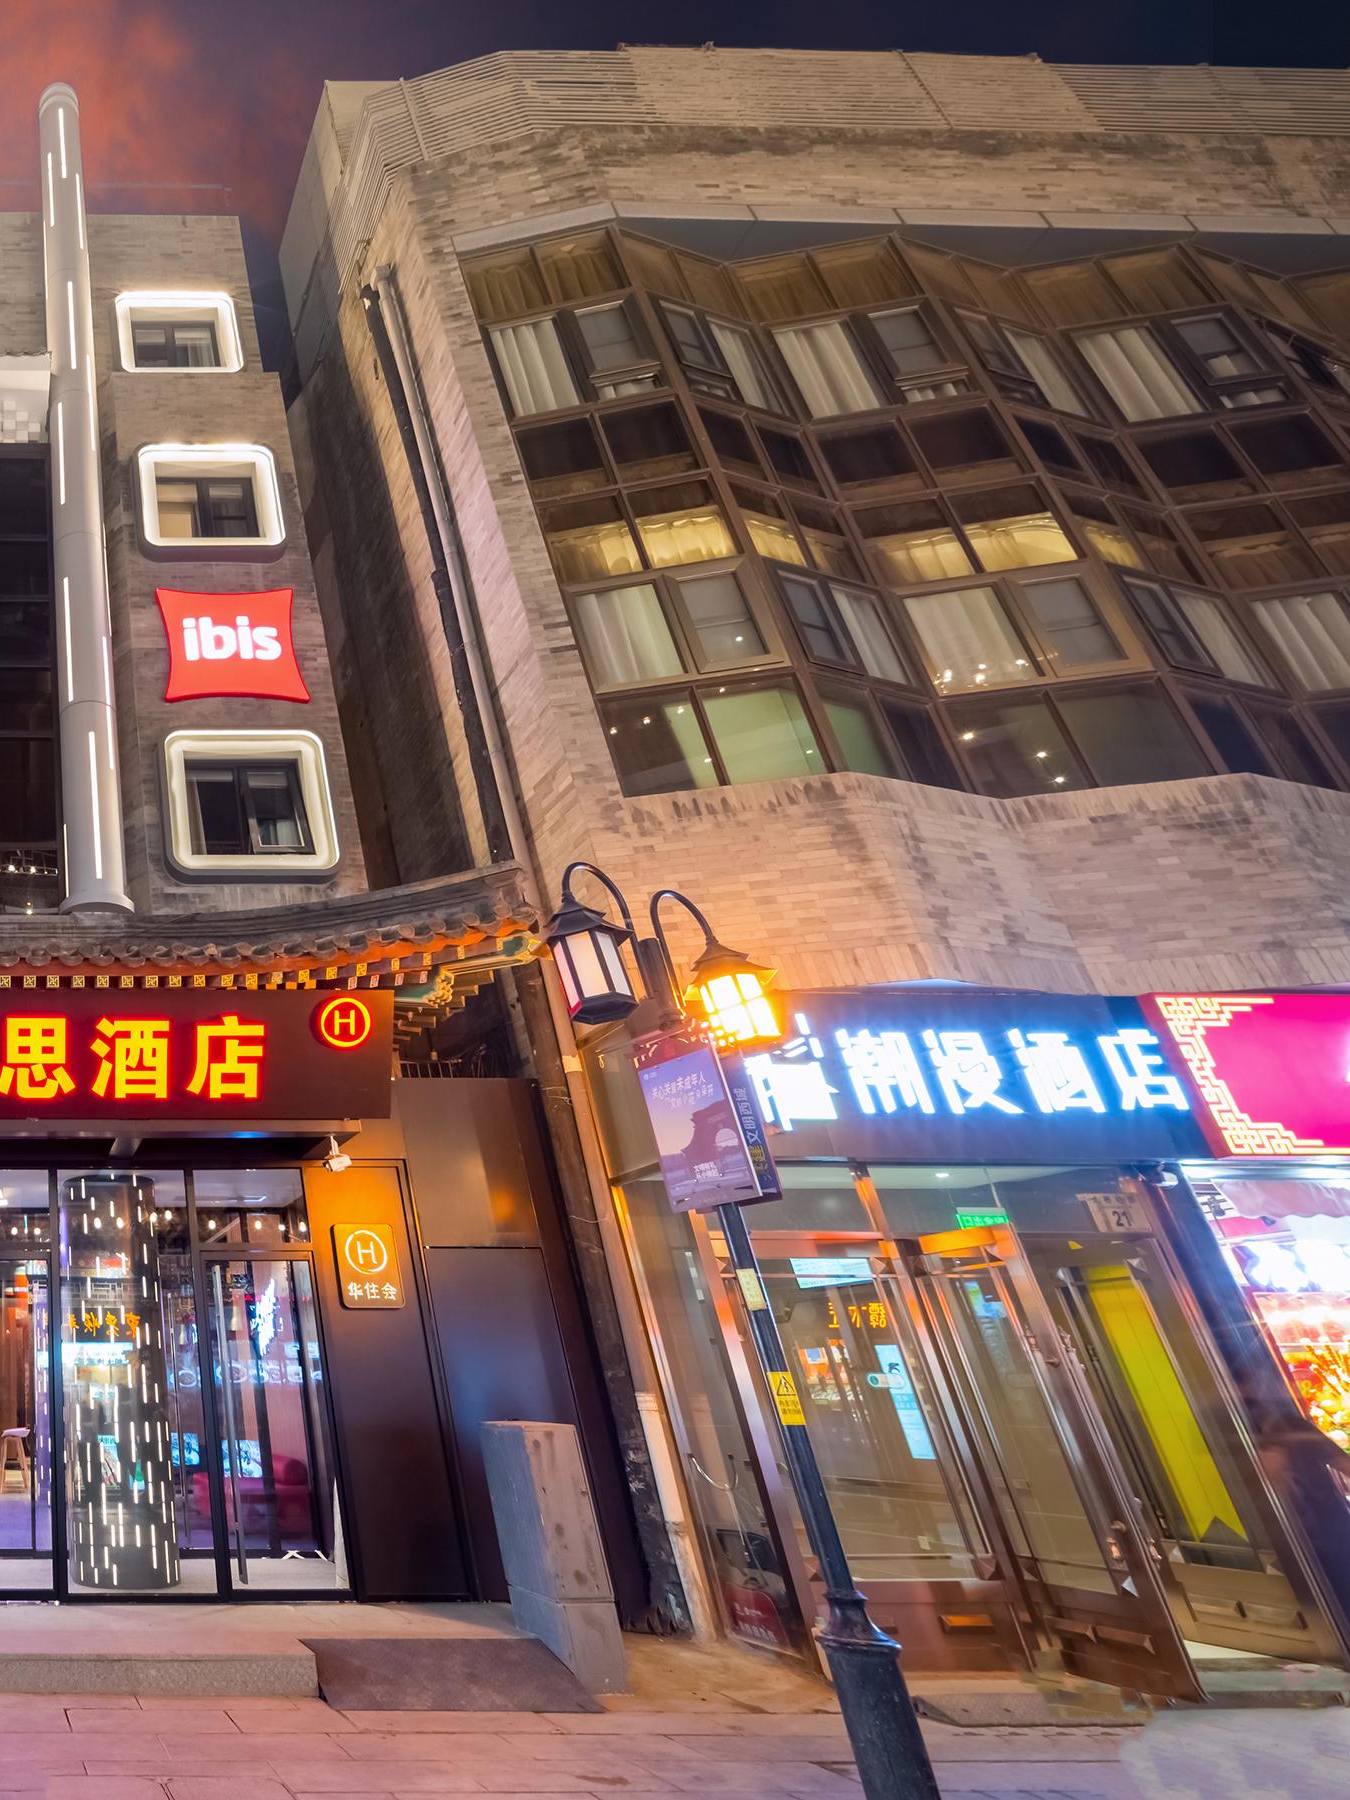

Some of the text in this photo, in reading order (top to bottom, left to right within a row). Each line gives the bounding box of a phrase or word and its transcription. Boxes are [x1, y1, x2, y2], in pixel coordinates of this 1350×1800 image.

[182, 616, 282, 661] ibis
[1112, 1210, 1133, 1227] 21
[347, 1281, 398, 1301] 华住会
